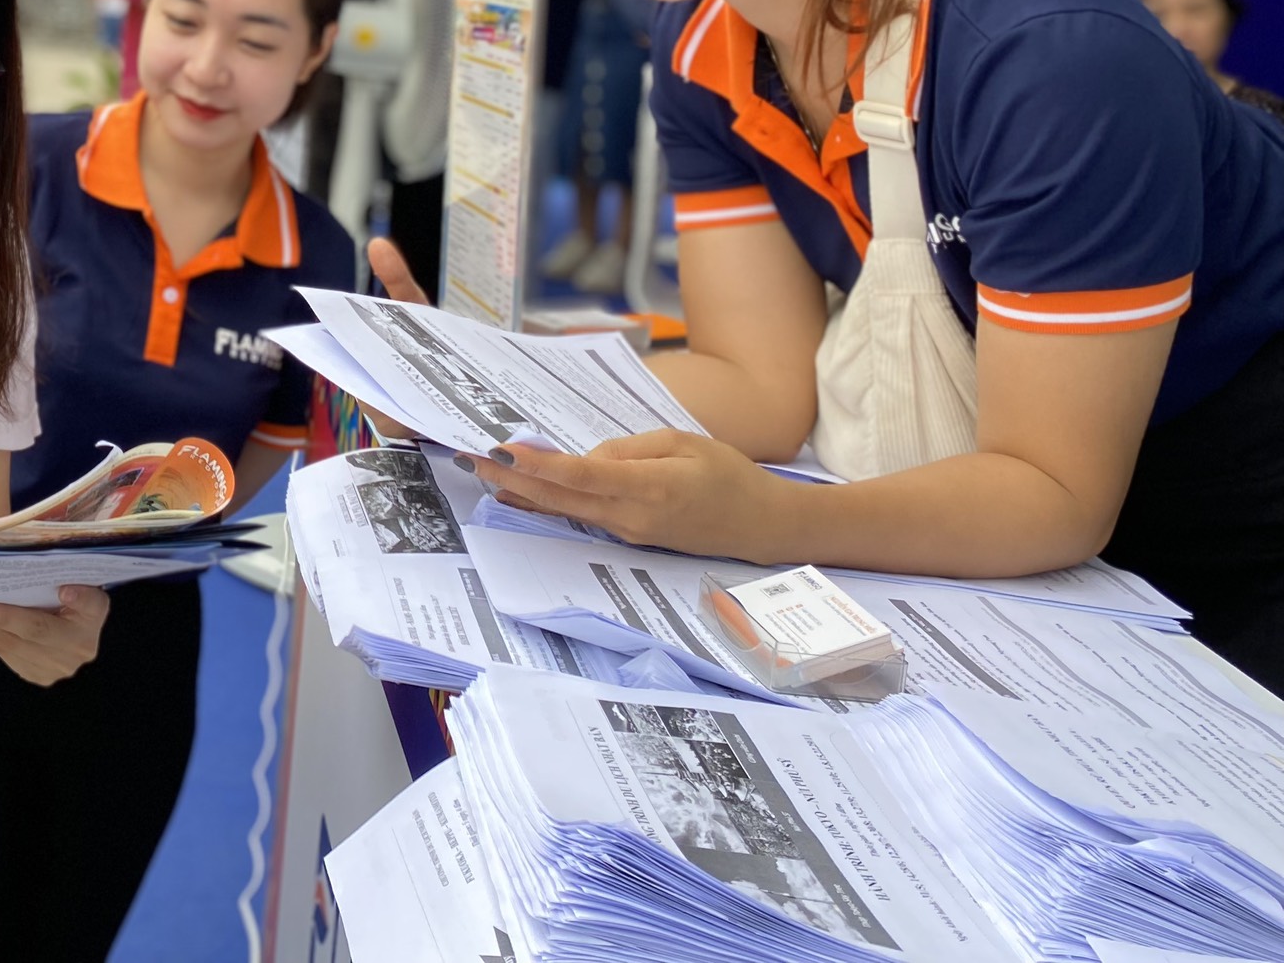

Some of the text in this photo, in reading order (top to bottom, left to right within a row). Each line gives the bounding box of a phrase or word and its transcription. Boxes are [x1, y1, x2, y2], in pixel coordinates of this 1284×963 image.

[608, 765, 628, 785] LỊCH
[620, 788, 635, 797] DU
[626, 799, 649, 824] TRÌNH
[814, 811, 844, 839] TOKYO
[839, 841, 868, 871] TRÌNH:
[861, 874, 890, 901] HÀNH
